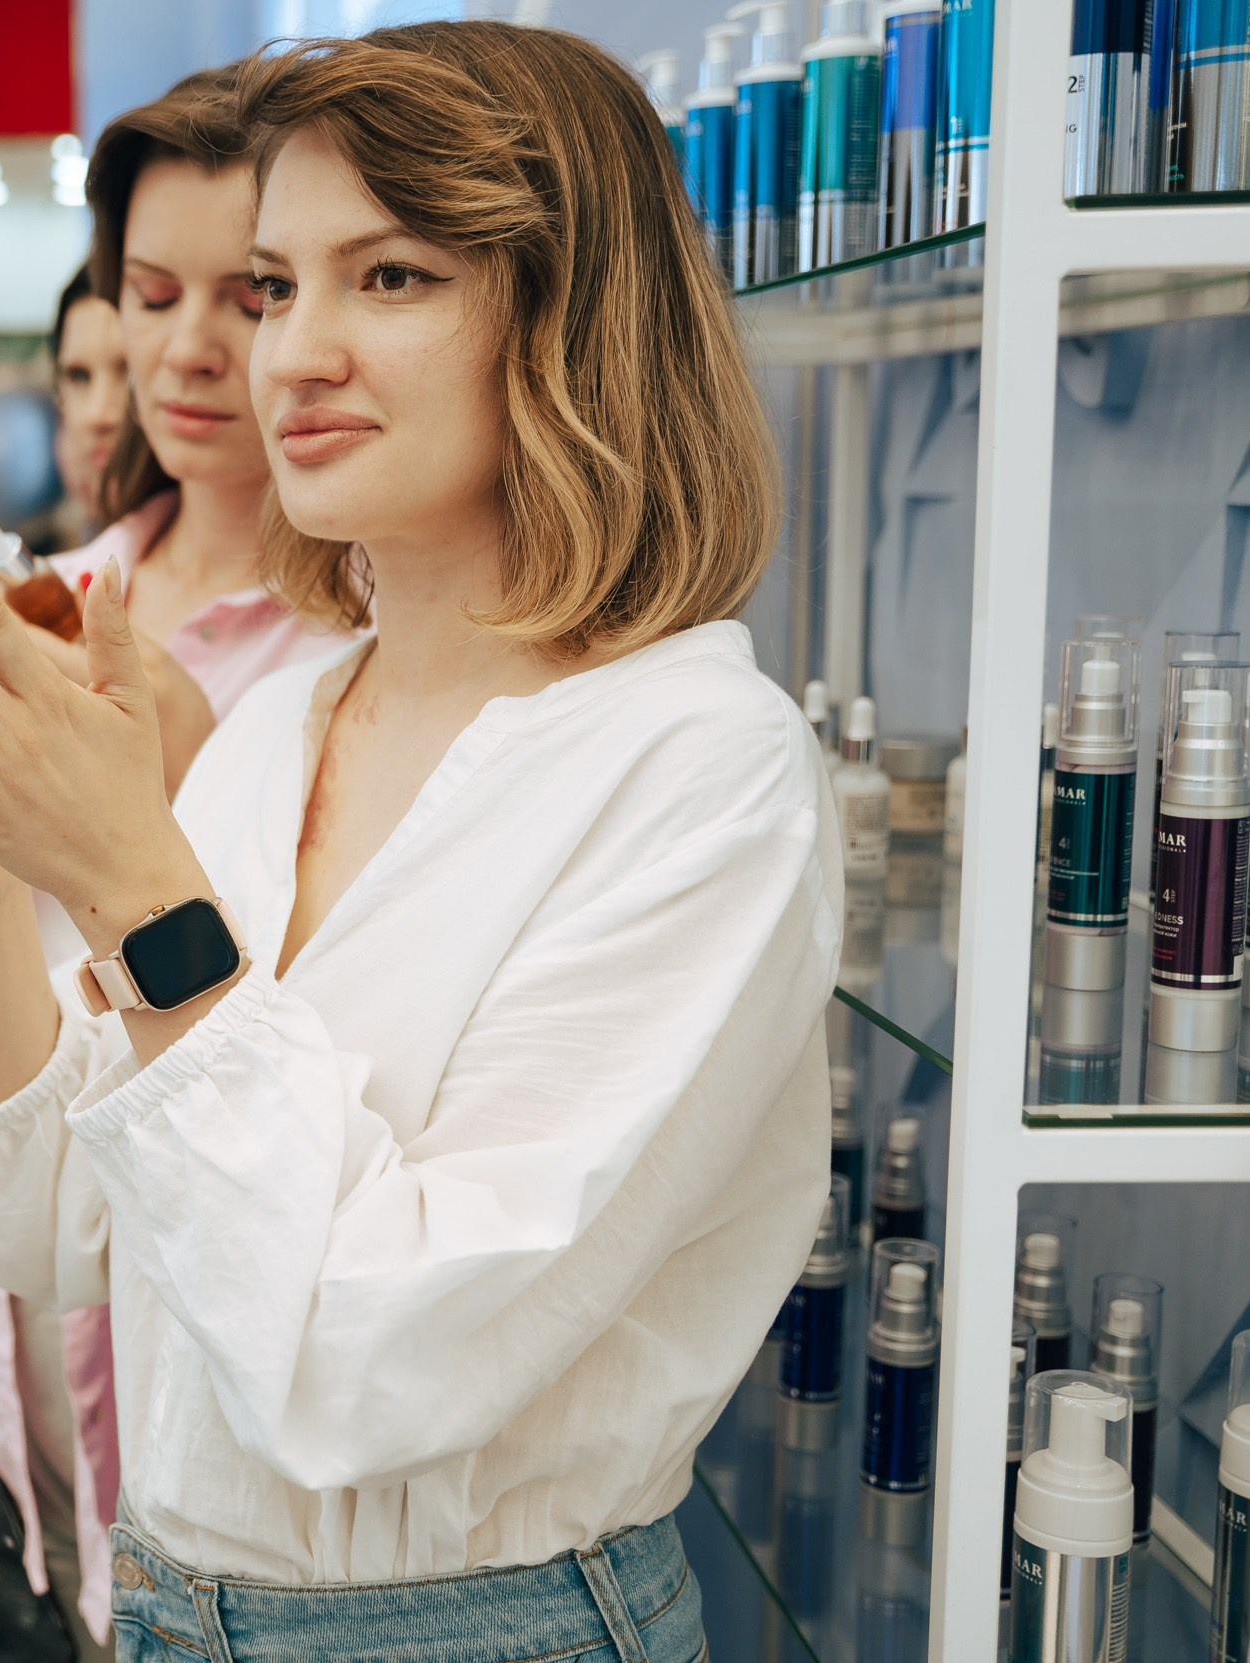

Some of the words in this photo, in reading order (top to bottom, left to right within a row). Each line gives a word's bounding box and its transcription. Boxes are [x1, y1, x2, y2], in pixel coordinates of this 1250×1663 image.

[1067, 76, 1078, 93] 2
[1058, 837, 1067, 849] 4
[1158, 831, 1187, 847] MAR
[1162, 888, 1170, 902] 4
